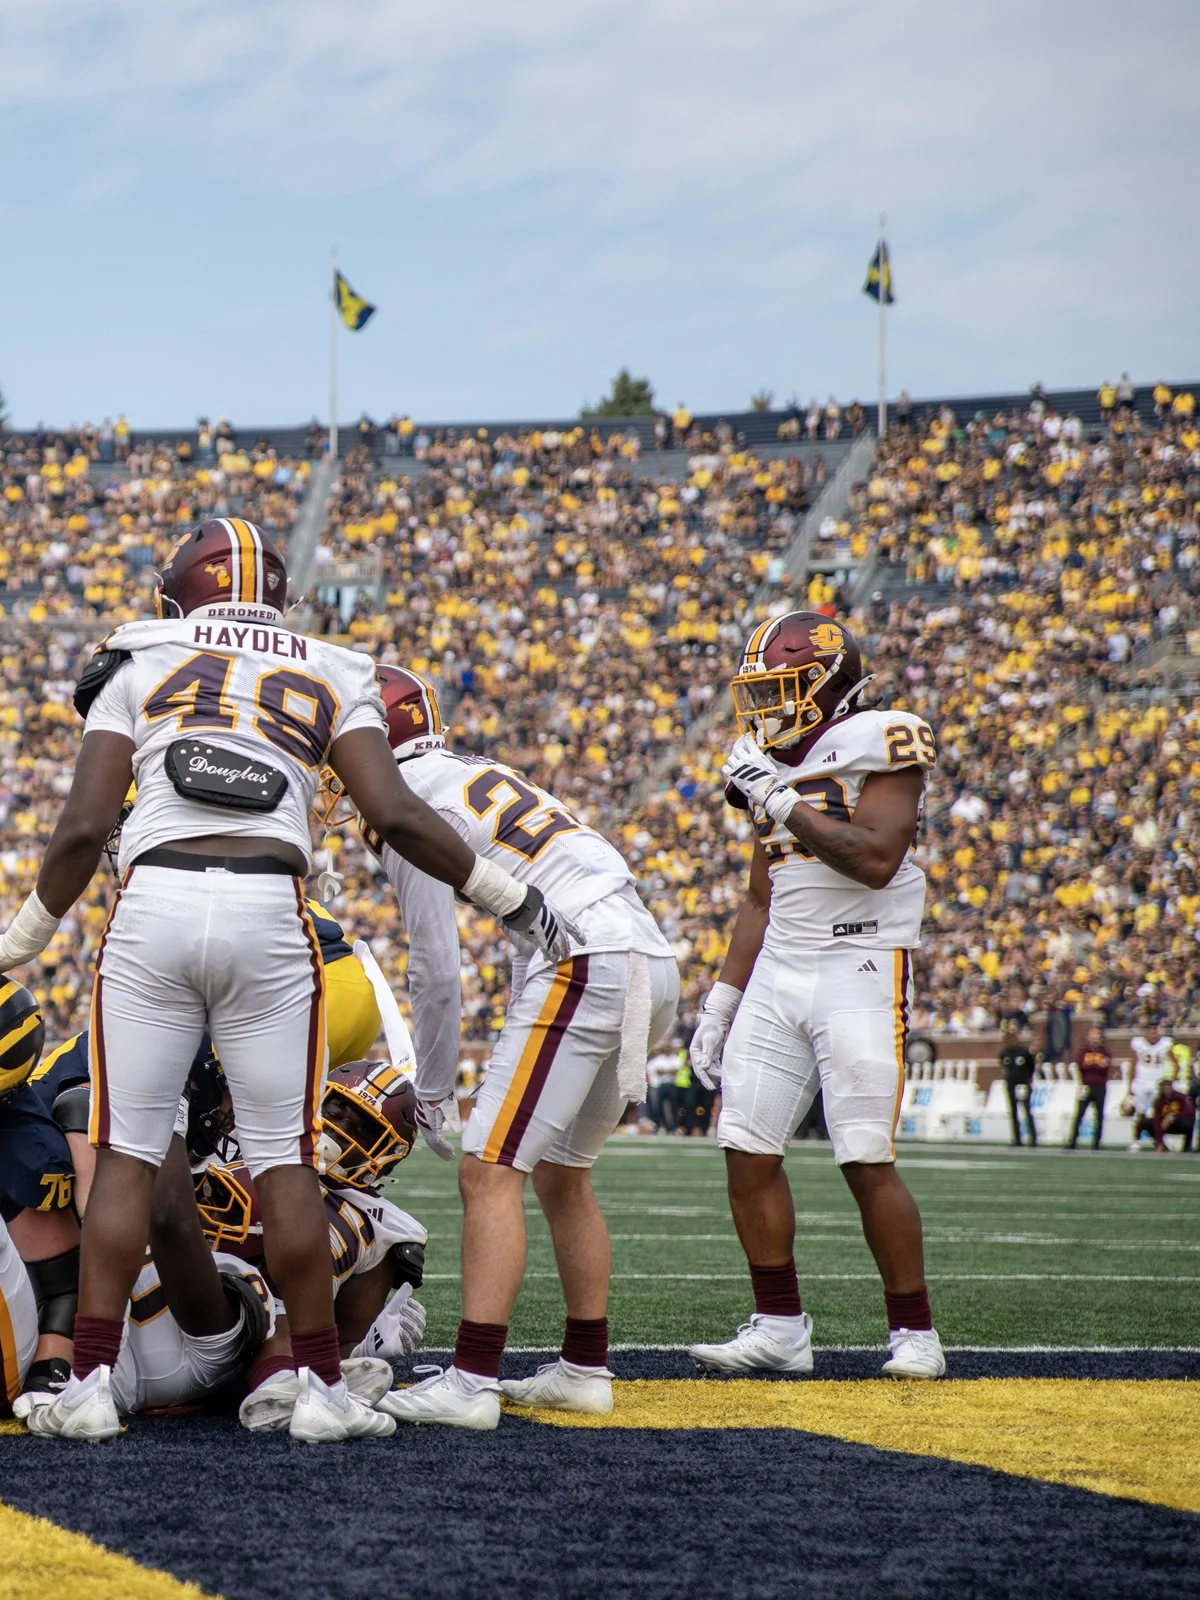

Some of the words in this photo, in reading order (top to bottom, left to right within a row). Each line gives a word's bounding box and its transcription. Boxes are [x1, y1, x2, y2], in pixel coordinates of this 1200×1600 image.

[208, 607, 277, 621] DEROMEDI
[194, 625, 307, 661] HAYDEN
[742, 664, 757, 674] 1974
[142, 651, 342, 771] 49
[883, 722, 937, 768] 29
[189, 756, 268, 784] Douglas
[464, 768, 592, 863] 2
[358, 1090, 377, 1106] 1974
[36, 1174, 75, 1212] 76
